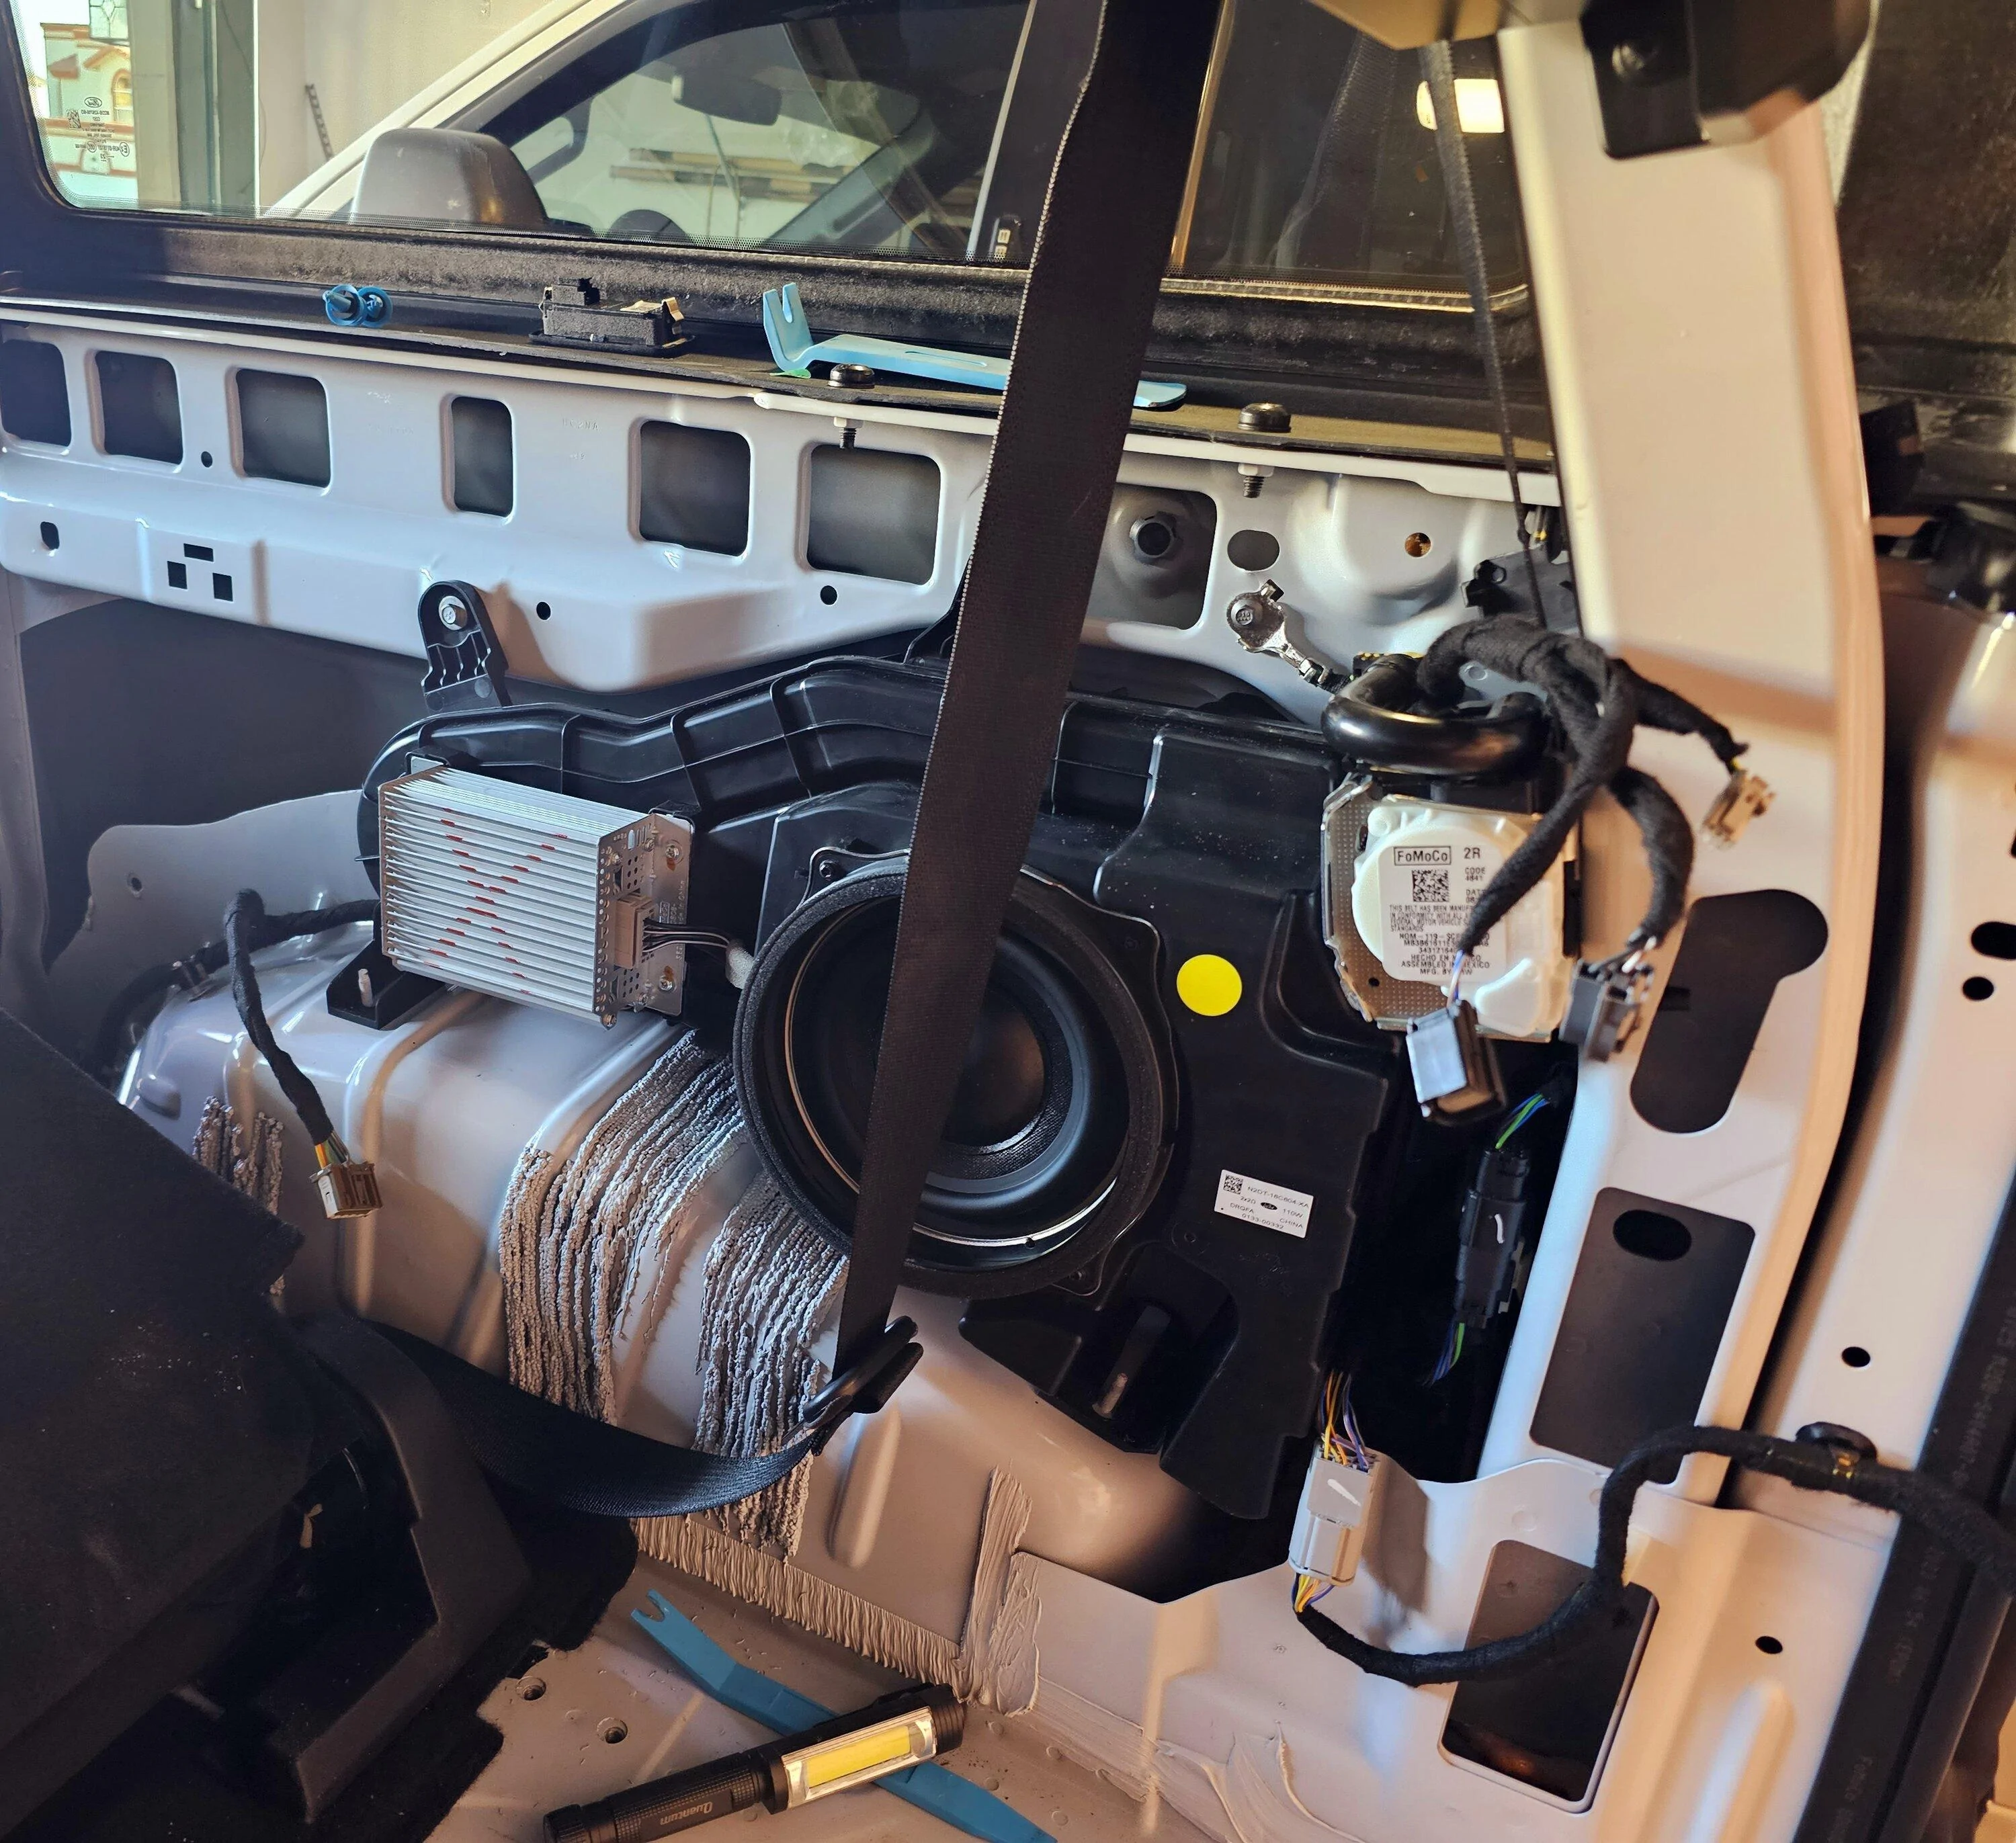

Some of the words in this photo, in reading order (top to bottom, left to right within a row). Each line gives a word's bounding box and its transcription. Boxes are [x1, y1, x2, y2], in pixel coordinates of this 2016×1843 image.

[1398, 850, 1448, 862] FoMoCo
[1464, 847, 1480, 859] 2R
[1279, 1218, 1304, 1228] CHINA
[660, 1801, 713, 1825] Quantum
